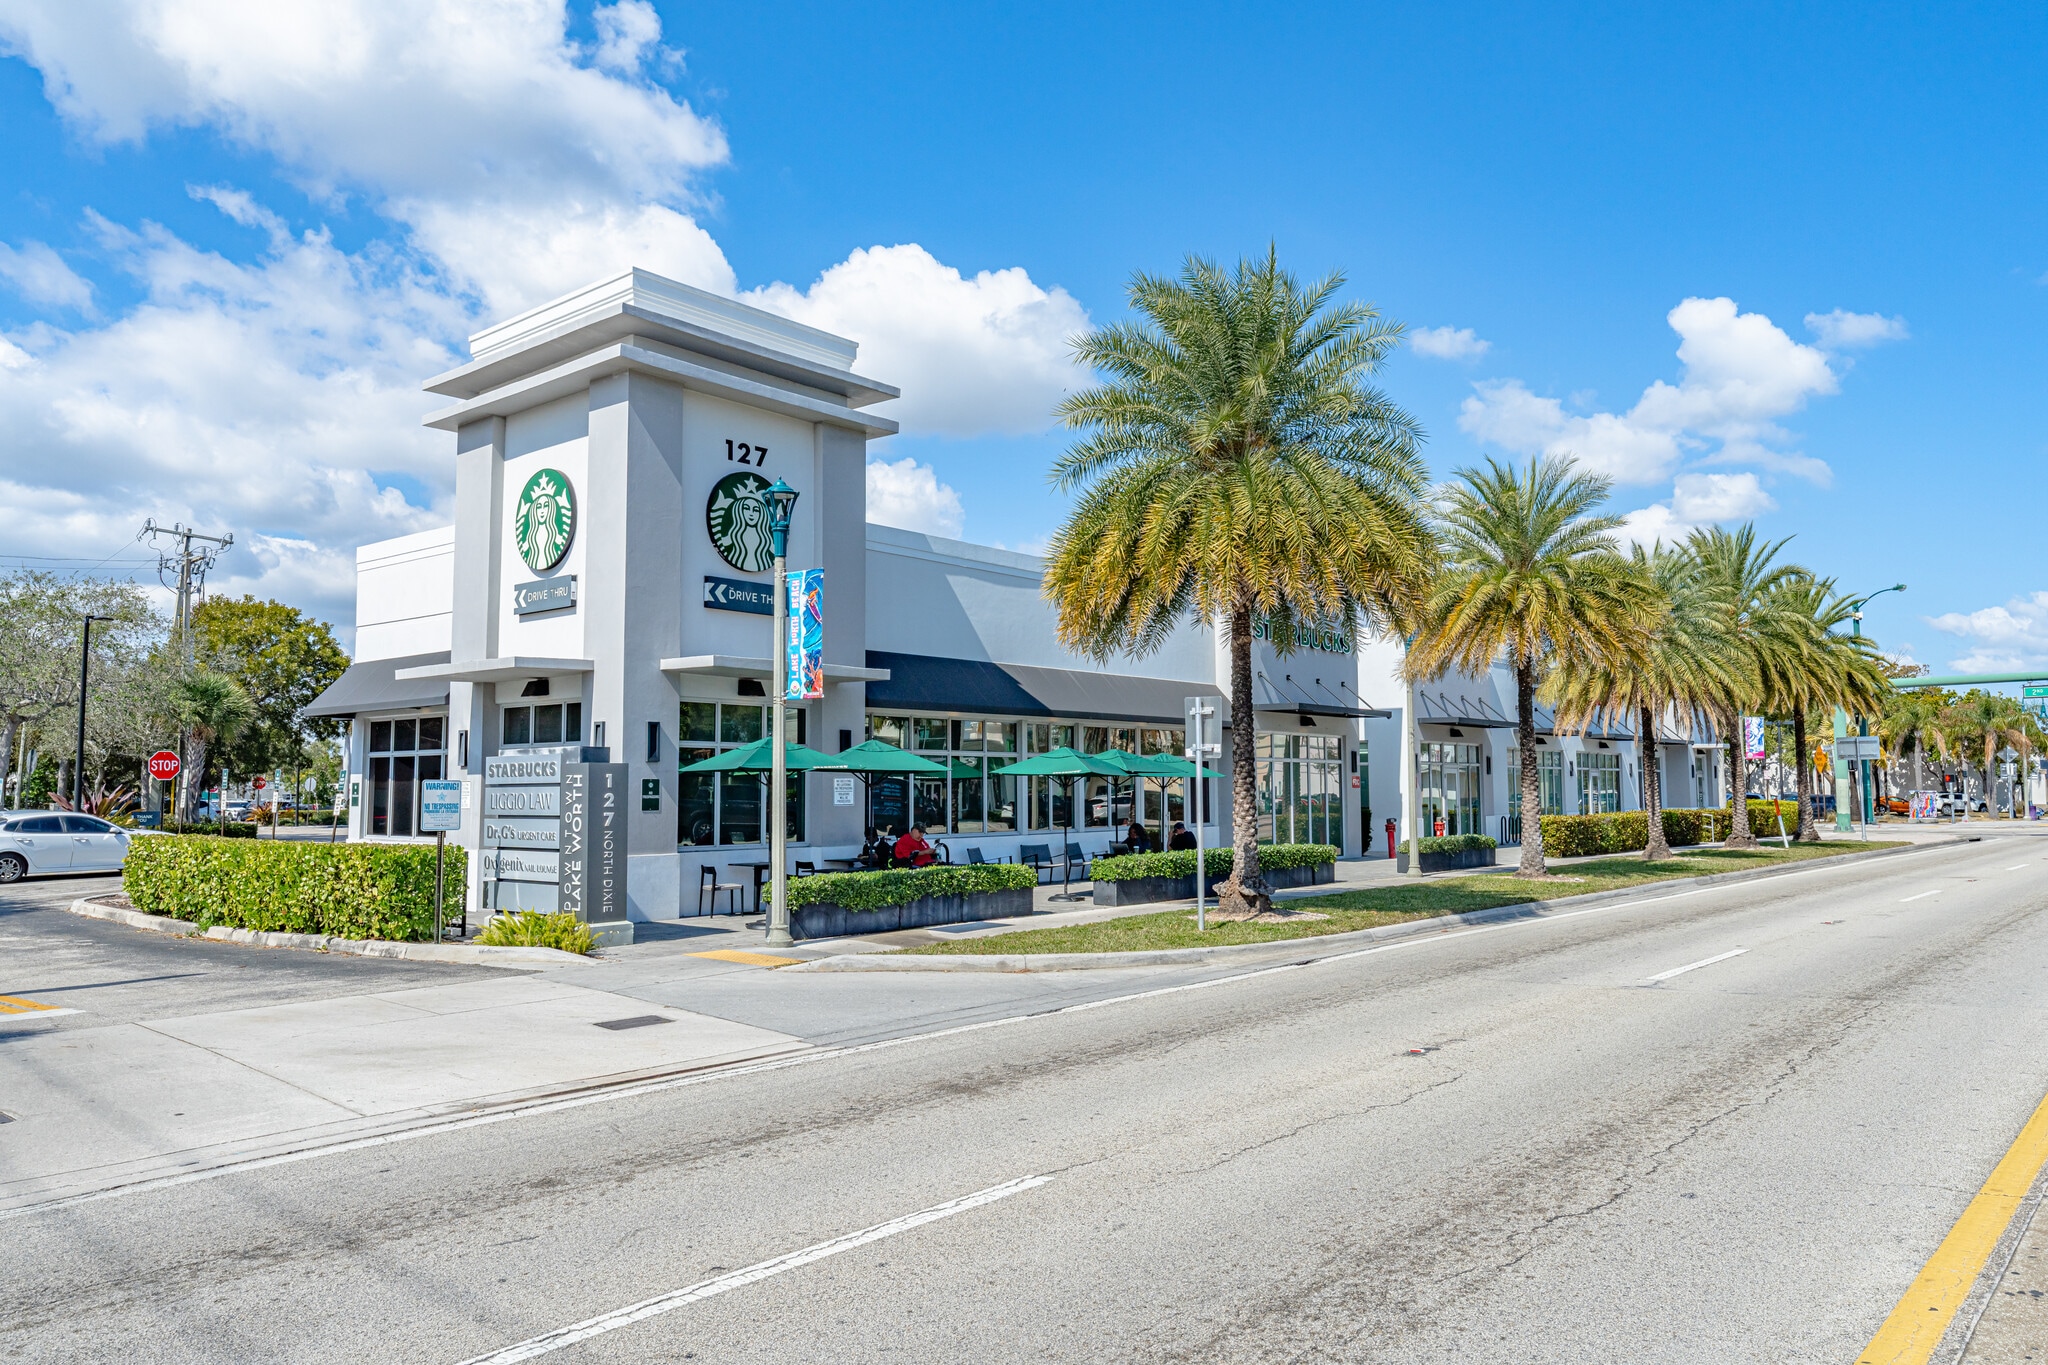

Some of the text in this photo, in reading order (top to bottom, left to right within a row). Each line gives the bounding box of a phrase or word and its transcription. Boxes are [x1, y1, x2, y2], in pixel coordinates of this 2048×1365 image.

[725, 439, 768, 467] 127
[527, 586, 569, 603] DRIVE THRU
[728, 589, 774, 605] DRIVE TH
[791, 579, 800, 679] LAKE WORTH BEACH
[1254, 619, 1351, 654] STRBUCKS
[151, 760, 178, 771] STOP
[488, 761, 557, 778] STARBUCKS
[425, 782, 460, 791] WARNING!
[490, 793, 525, 810] LIGGIO
[529, 792, 554, 810] LAW
[517, 831, 540, 841] URGENT
[540, 831, 556, 841] CARE
[572, 774, 583, 912] LAKE WORTH
[603, 831, 614, 912] NORTH DIXIE
